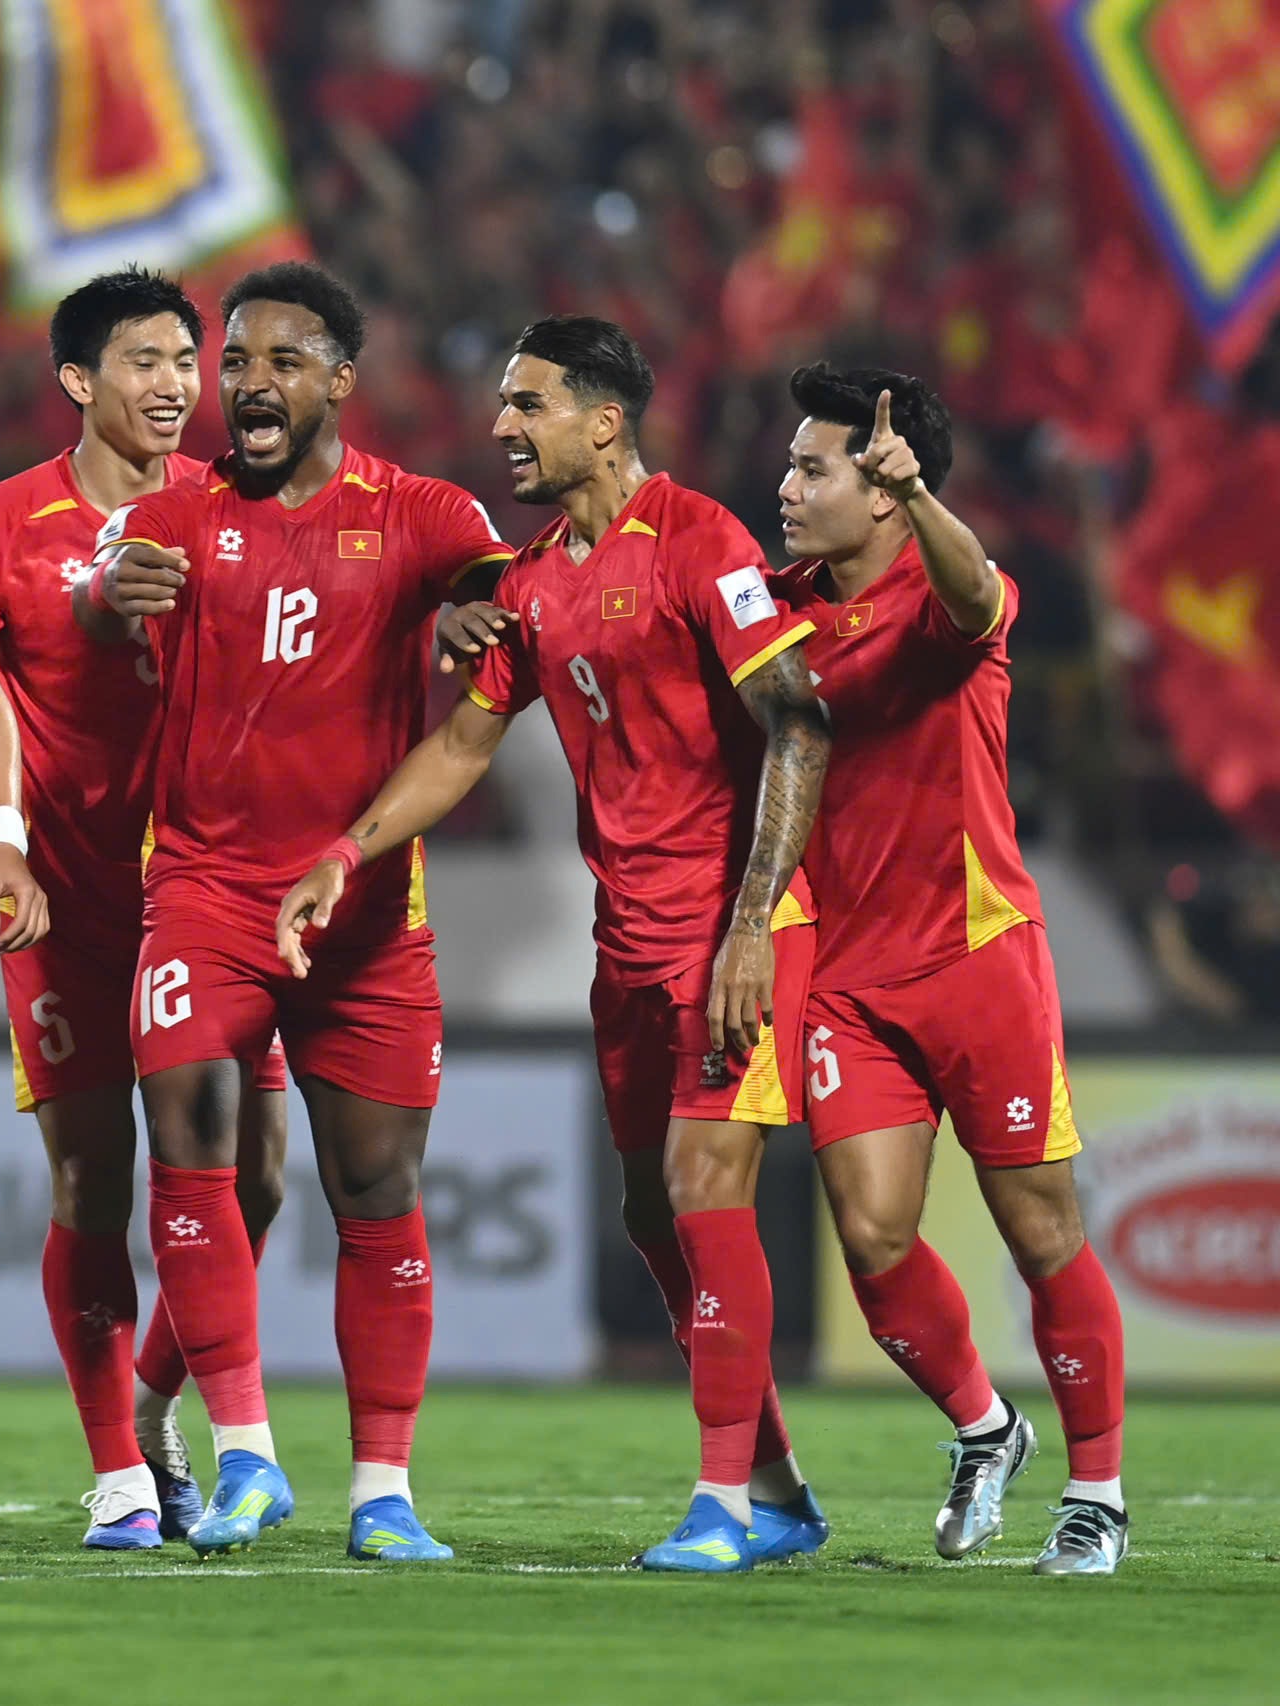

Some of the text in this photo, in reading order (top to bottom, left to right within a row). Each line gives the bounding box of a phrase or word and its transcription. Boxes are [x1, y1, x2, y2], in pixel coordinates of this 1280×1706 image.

[262, 586, 319, 665] 12
[733, 584, 762, 610] AFC
[567, 654, 610, 726] 9
[31, 991, 75, 1064] 5
[140, 958, 192, 1037] 12
